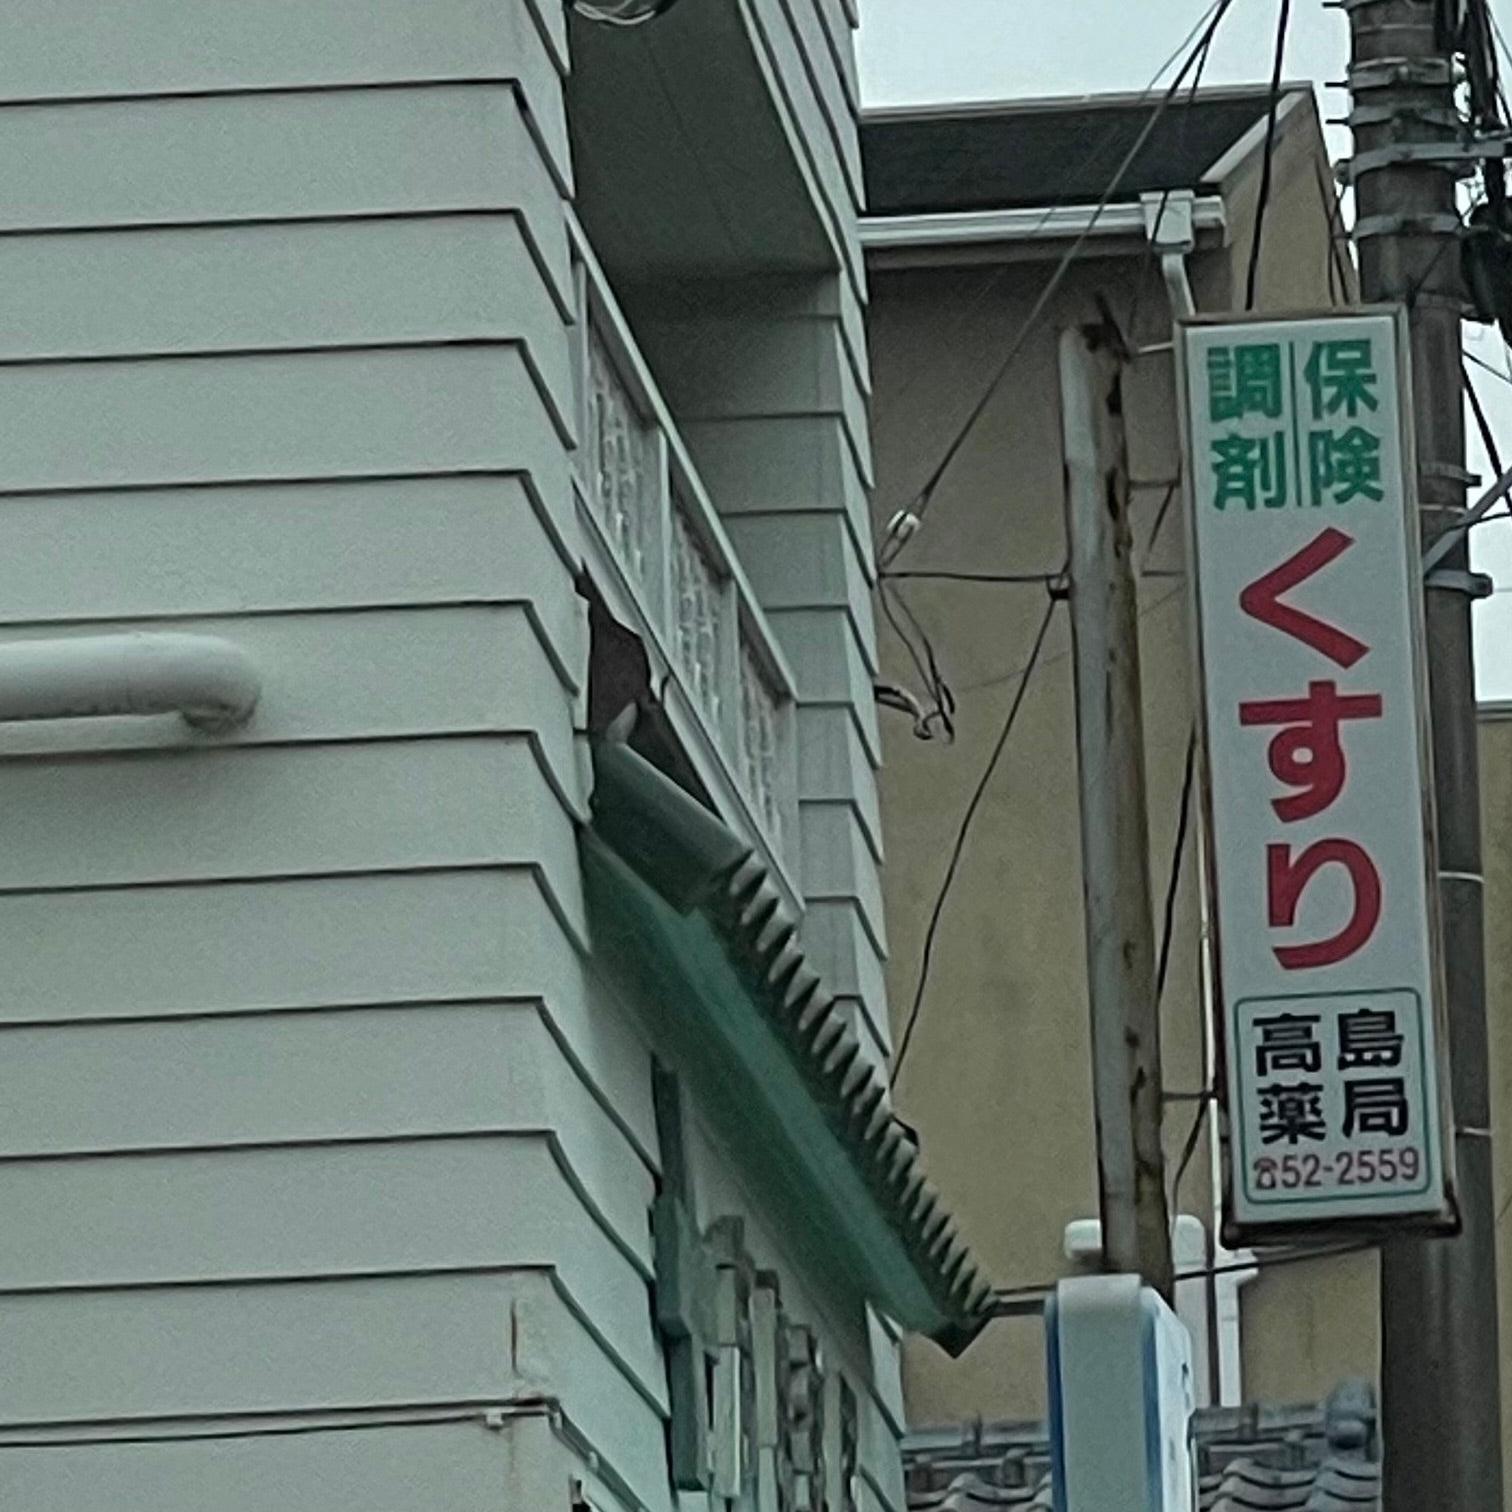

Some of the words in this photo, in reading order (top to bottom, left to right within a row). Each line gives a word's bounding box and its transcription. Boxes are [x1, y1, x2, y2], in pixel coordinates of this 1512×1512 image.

[1206, 343, 1288, 512] 調剤
[1303, 338, 1385, 508] 保険
[1238, 525, 1383, 971] くすり
[1252, 1008, 1405, 1077] 高島
[1256, 1077, 1409, 1145] 薬局
[1281, 1146, 1420, 1189] 52-2559
